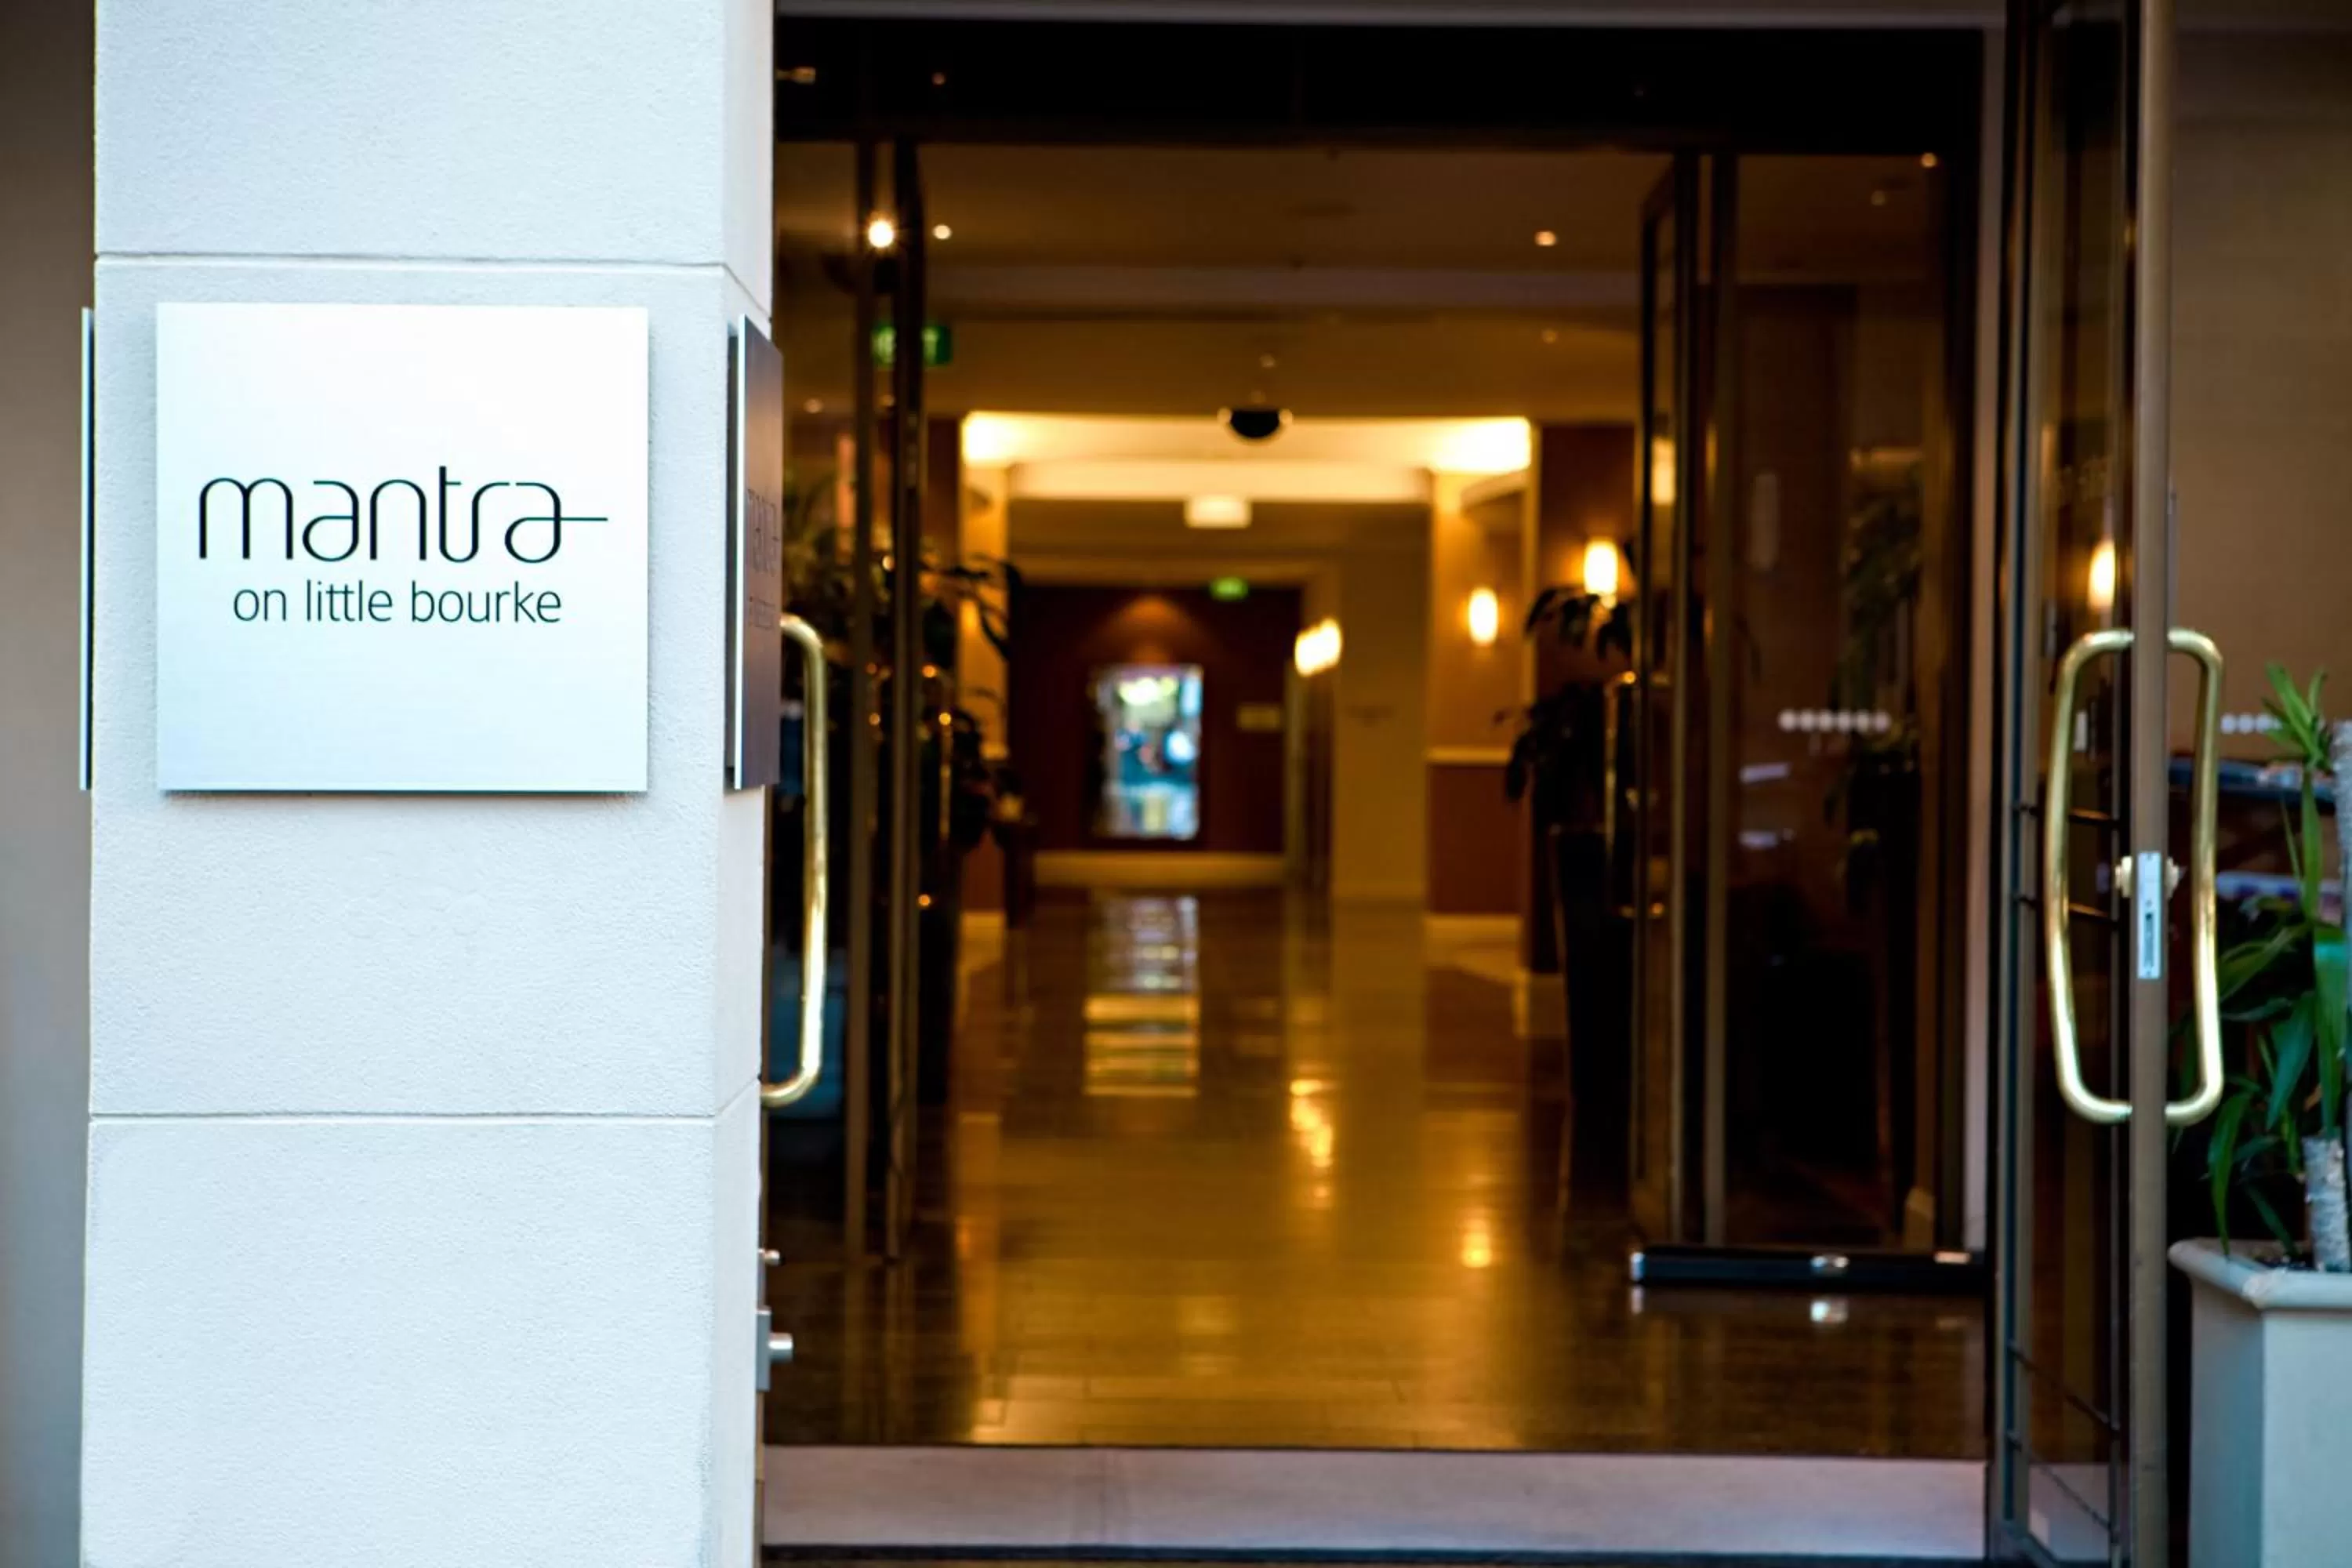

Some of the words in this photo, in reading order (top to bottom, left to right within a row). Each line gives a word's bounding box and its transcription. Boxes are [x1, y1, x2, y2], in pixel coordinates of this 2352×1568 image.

[198, 466, 608, 564] mantra
[233, 588, 286, 622] on
[306, 579, 393, 622] little
[411, 580, 561, 623] bourke
